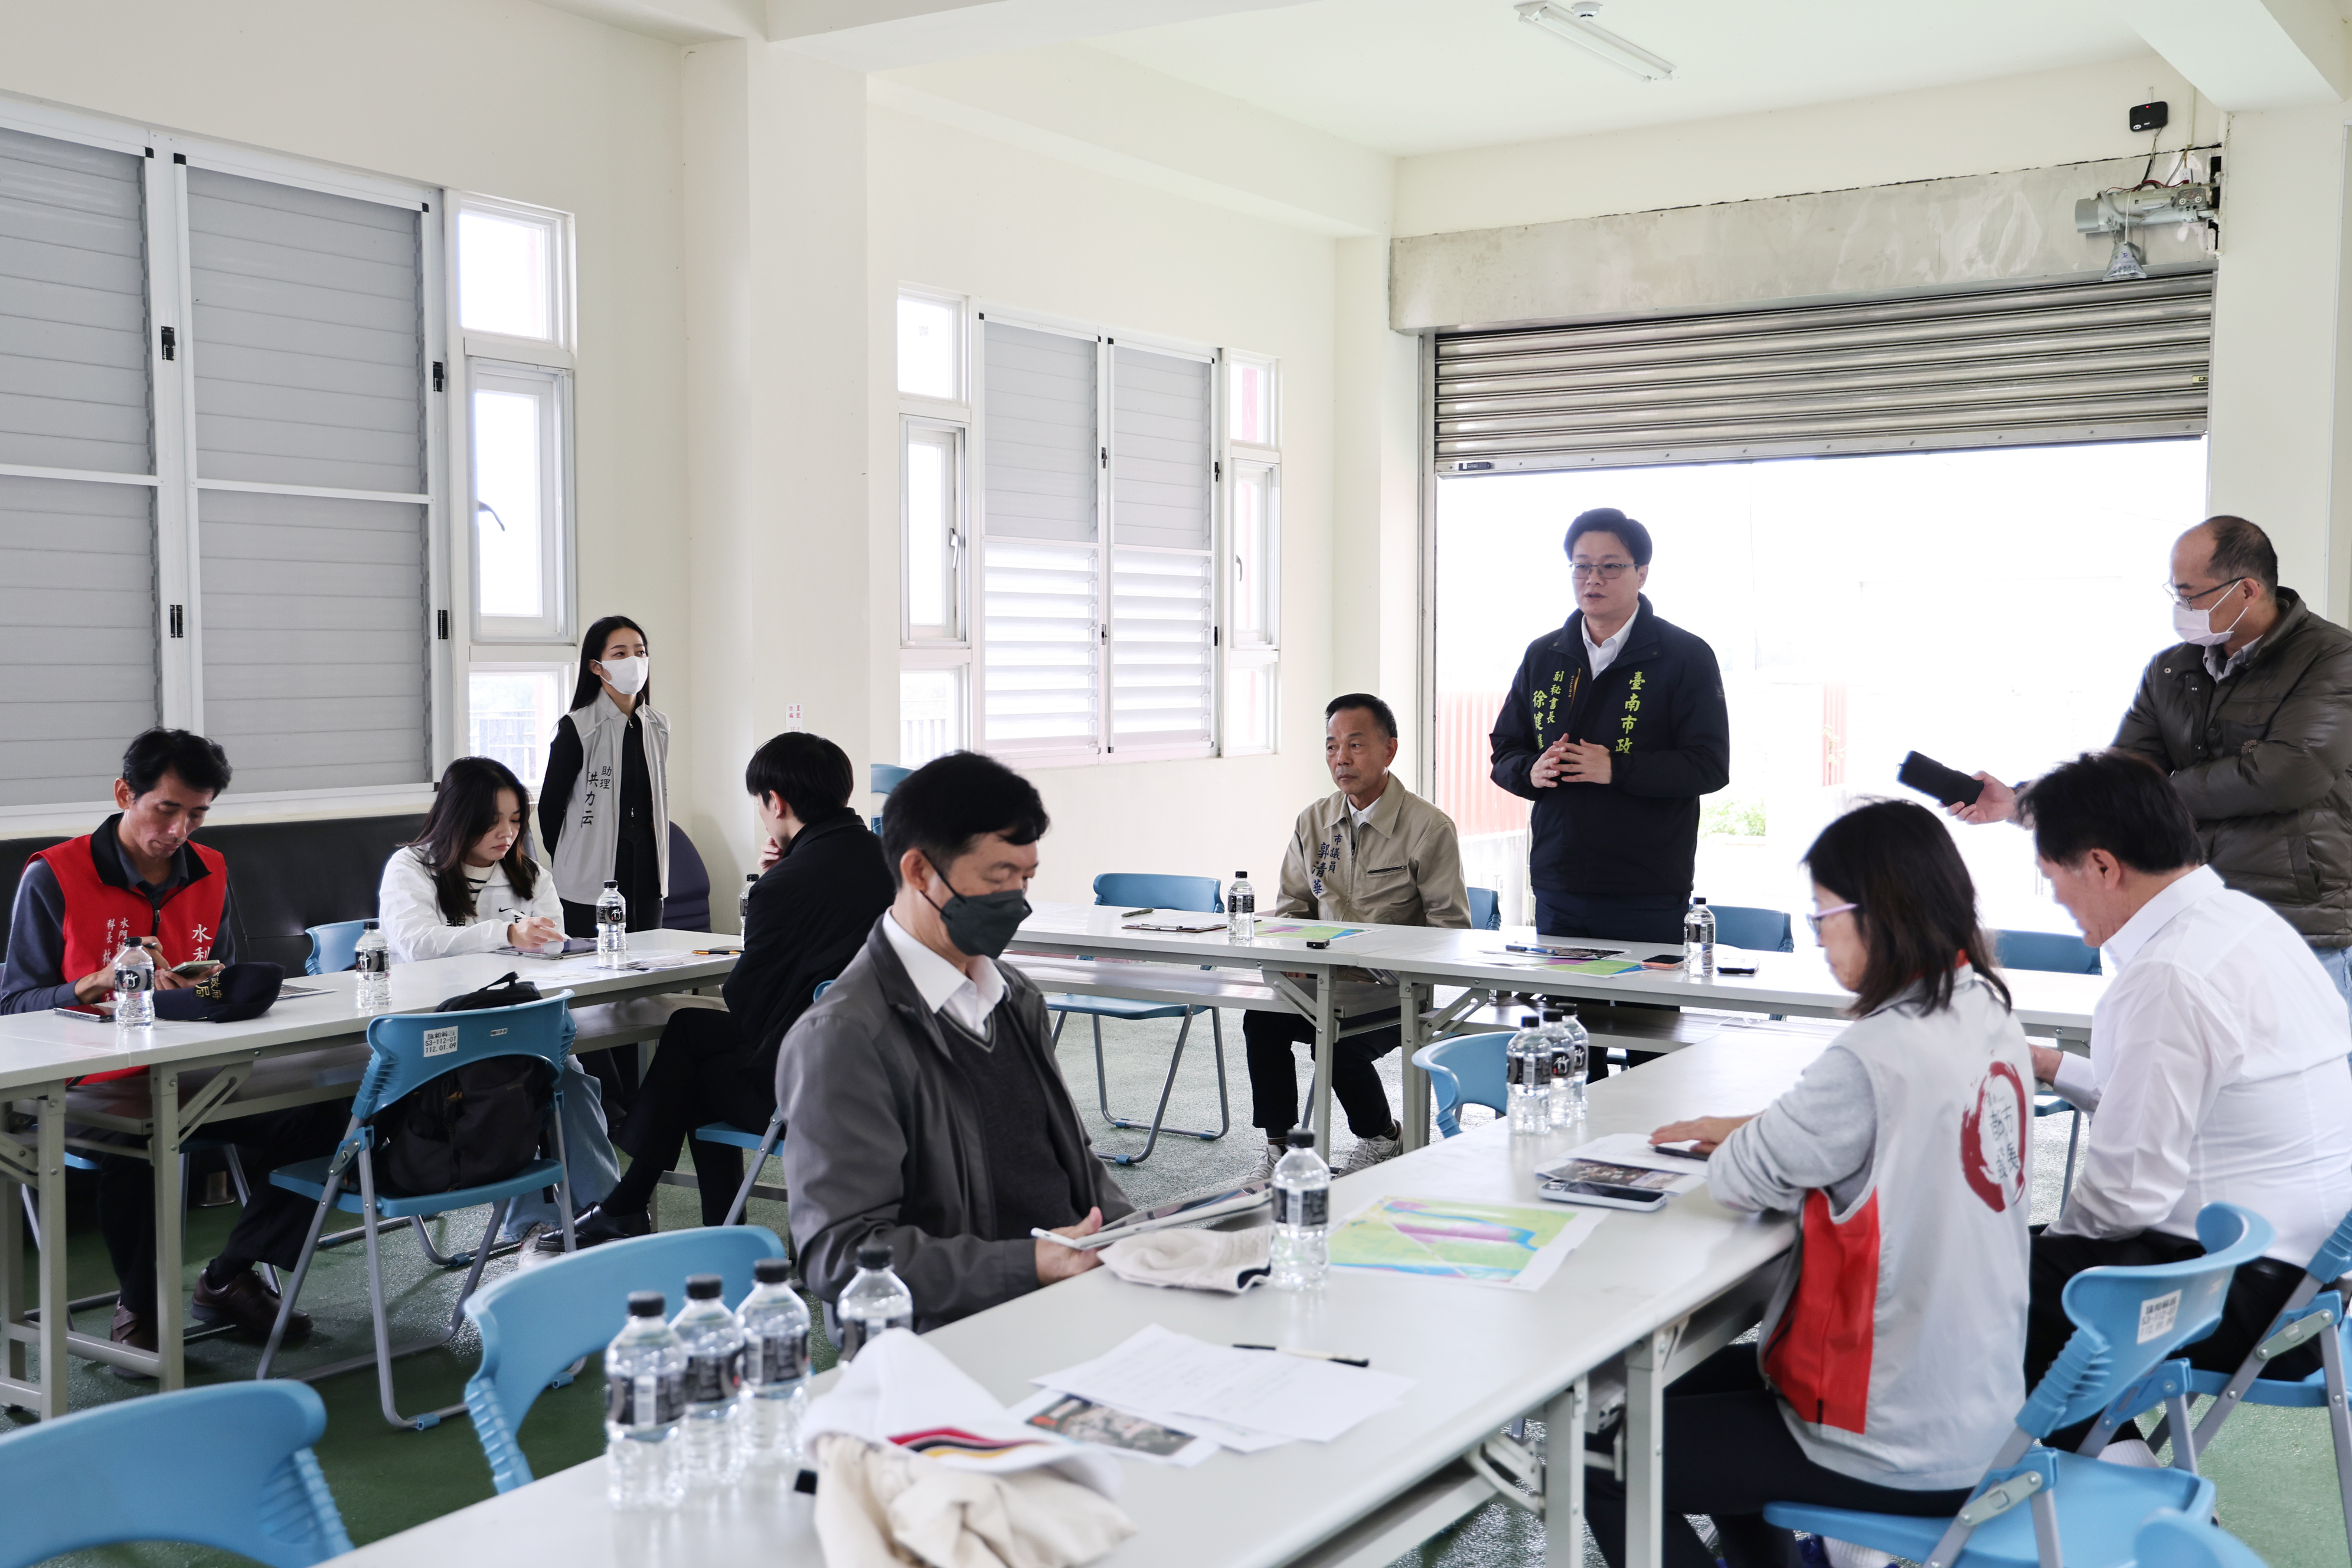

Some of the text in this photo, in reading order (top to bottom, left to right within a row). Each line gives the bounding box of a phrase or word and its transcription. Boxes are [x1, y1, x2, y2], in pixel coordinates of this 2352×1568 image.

[1547, 671, 1564, 724] 副秘書長
[600, 766, 612, 789] 助理
[1311, 842, 1330, 896] 郭清華
[1328, 834, 1342, 874] 市議員
[106, 918, 116, 943] 科長
[425, 1036, 456, 1046] S3-112-01
